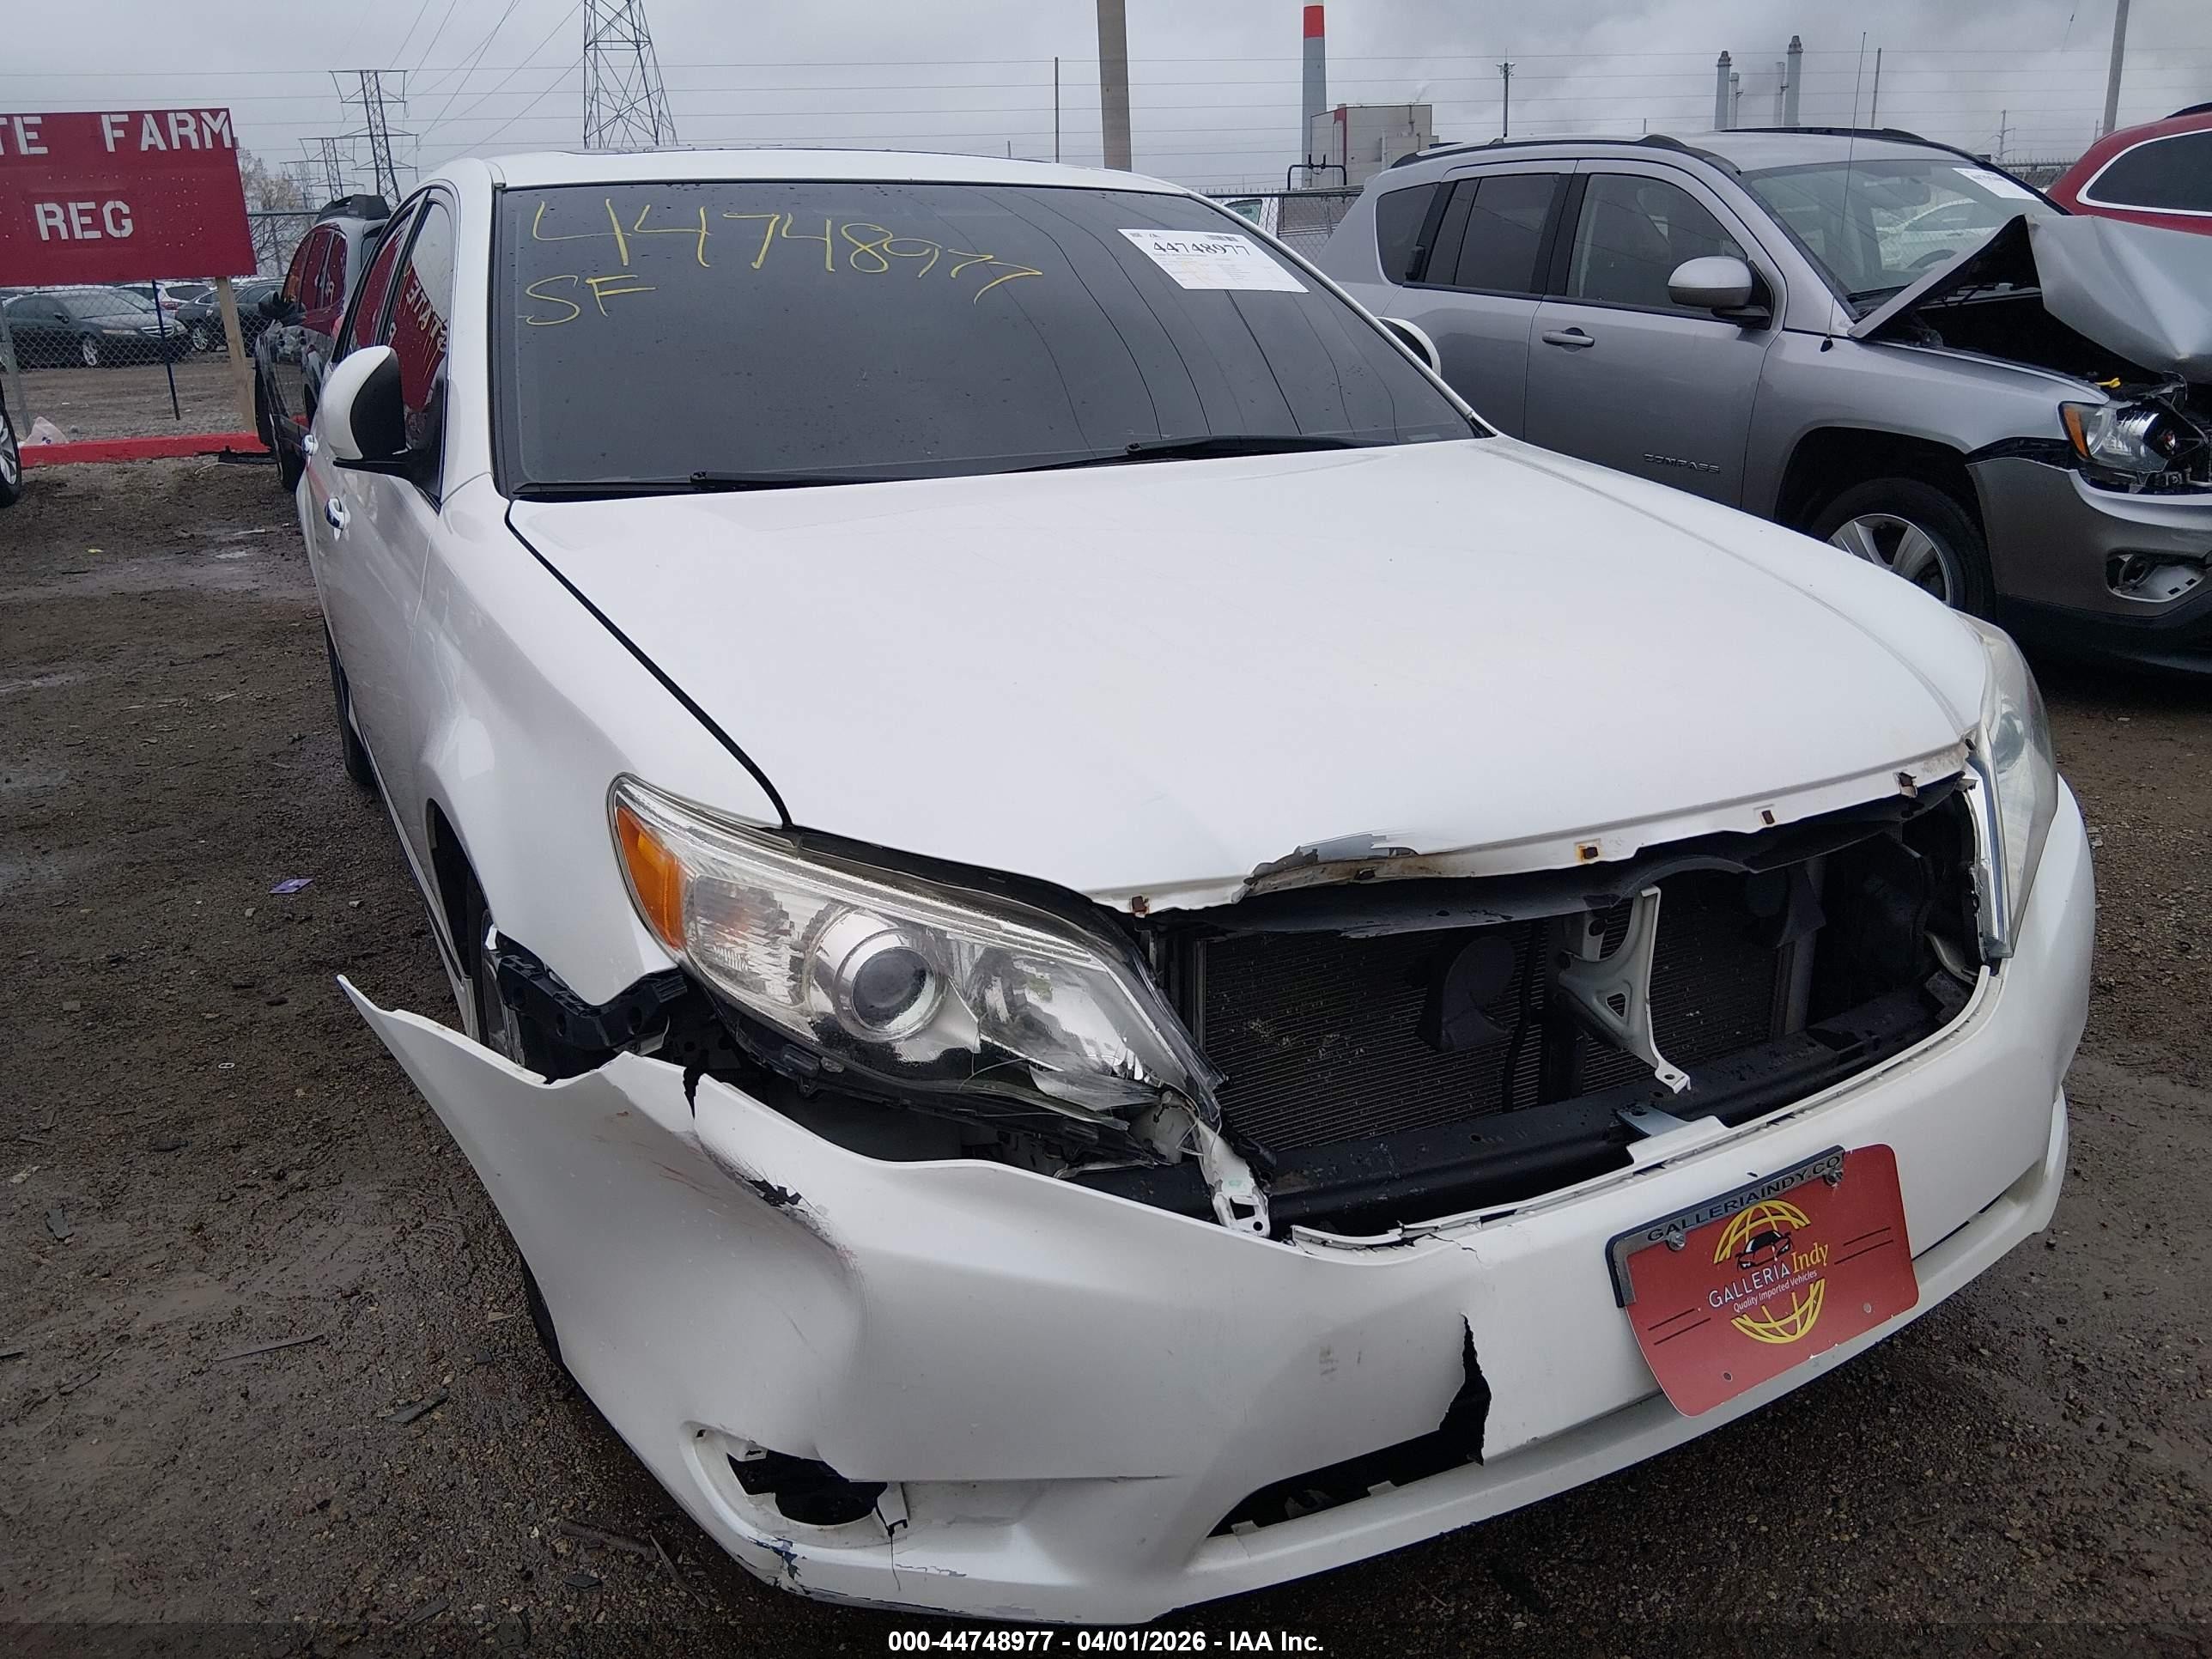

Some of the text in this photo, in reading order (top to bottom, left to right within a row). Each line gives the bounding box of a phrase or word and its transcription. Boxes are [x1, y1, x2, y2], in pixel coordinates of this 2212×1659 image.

[100, 111, 233, 153] FARM
[34, 200, 134, 241] REG
[532, 198, 1043, 305] 44748977
[1153, 241, 1251, 256] 44748977
[524, 274, 657, 326] SF
[1708, 1242, 1829, 1309] GALLERIA Indy
[1732, 1269, 1819, 1314] Quality Imported Vehicles
